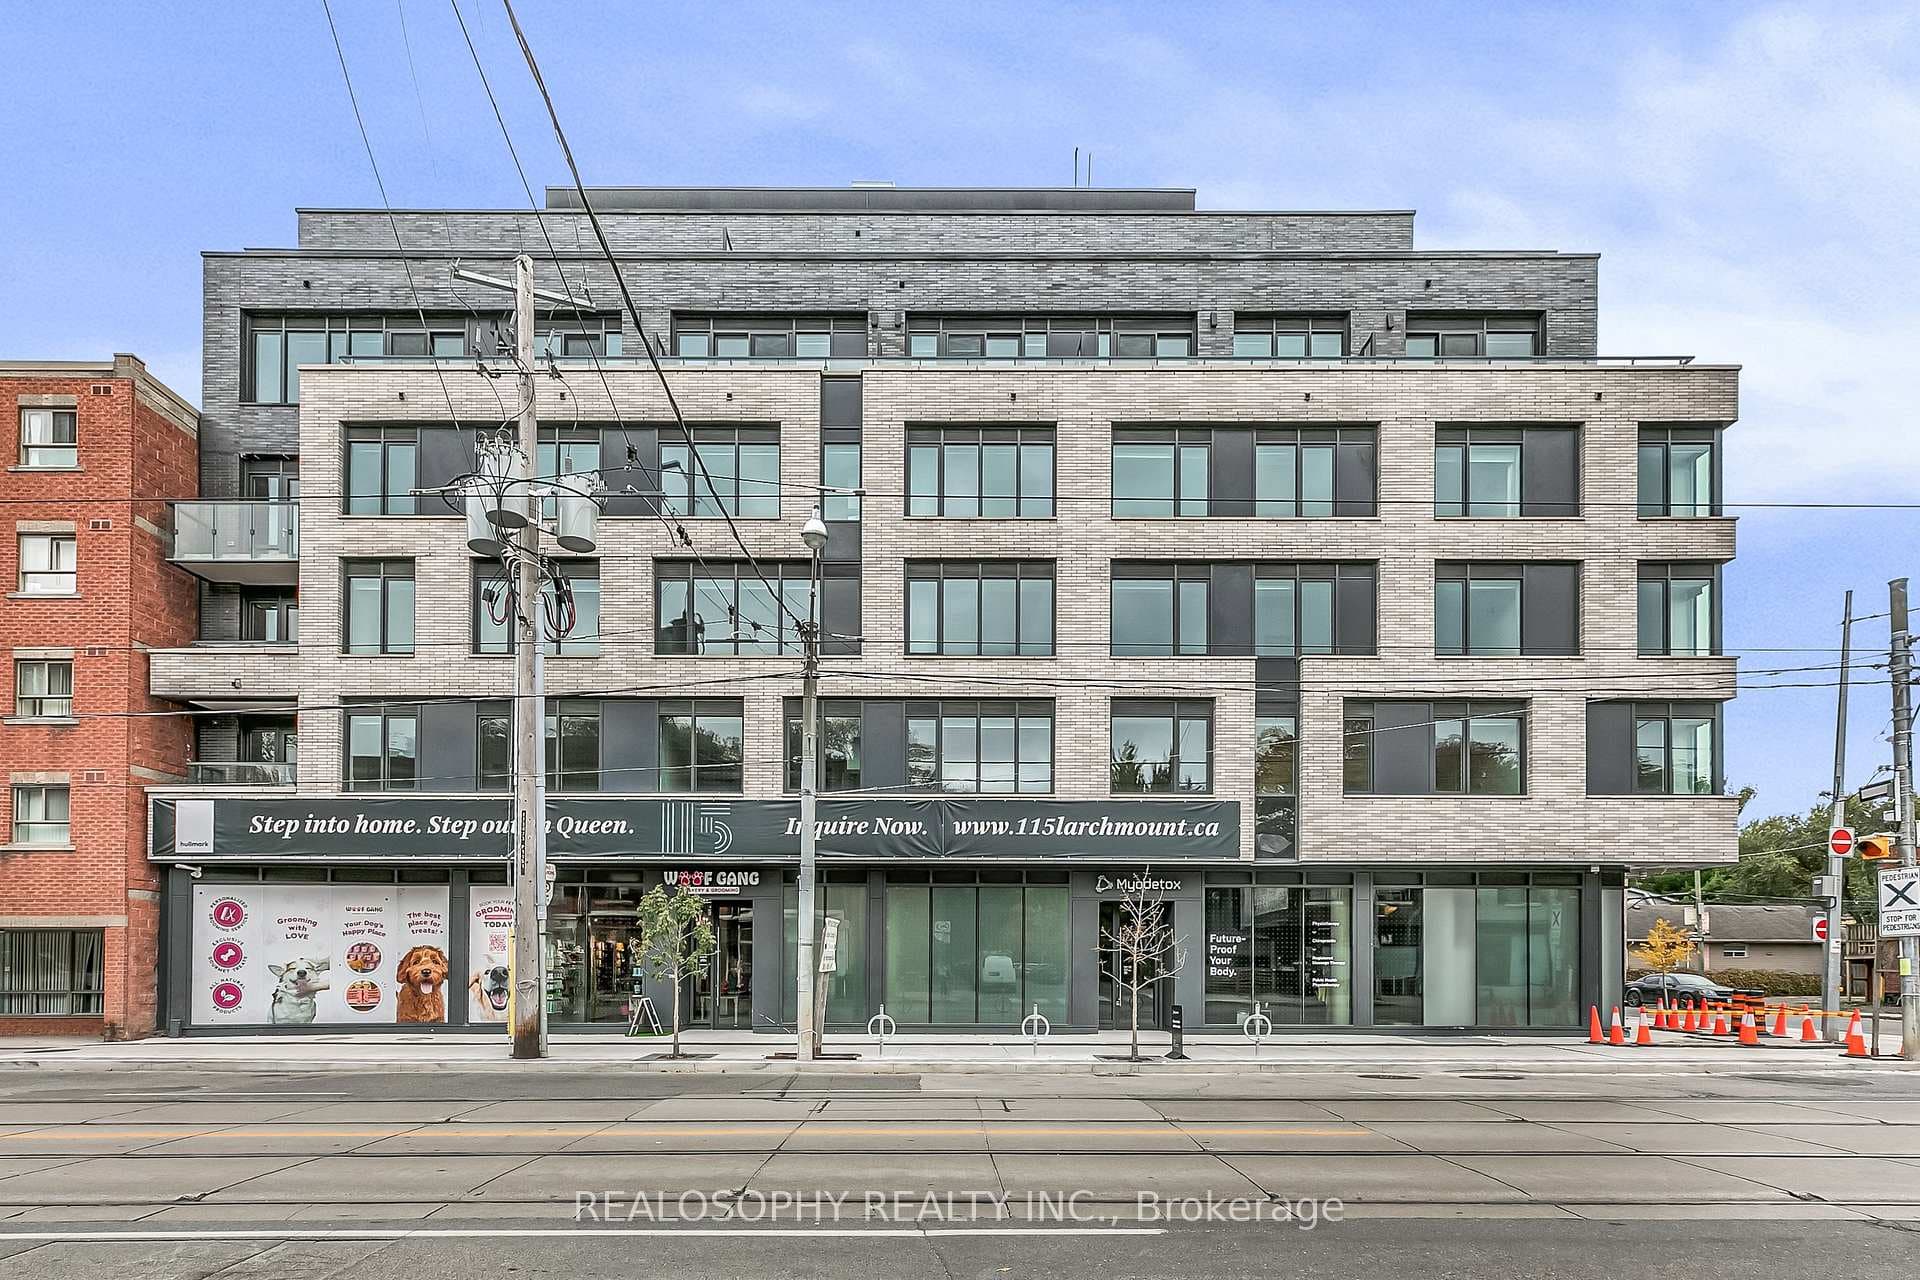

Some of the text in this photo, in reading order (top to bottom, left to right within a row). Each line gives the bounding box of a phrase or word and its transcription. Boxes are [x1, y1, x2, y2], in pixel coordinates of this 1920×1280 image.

[249, 814, 300, 839] Step
[304, 813, 350, 834] into
[354, 813, 422, 834] home.
[427, 815, 478, 840] Step
[556, 816, 634, 838] Queen.
[872, 817, 928, 835] Now.
[952, 816, 1220, 837] www.115larchmount.ca
[180, 840, 209, 848] hullmark
[716, 871, 760, 886] GANG
[1881, 872, 1919, 881] PEDESTRIAN
[1116, 878, 1181, 893] Myodetox
[424, 911, 441, 919] best
[475, 905, 515, 917] GROOMIN
[277, 917, 318, 927] Grooming
[1886, 914, 1917, 923] STOP FOR
[364, 920, 384, 928] Dog's
[408, 920, 428, 928] place
[342, 929, 386, 937] Happy Place
[1210, 934, 1246, 943] Future-
[1210, 945, 1237, 954] Proof
[1210, 956, 1232, 965] Your
[1210, 967, 1237, 977] Body.
